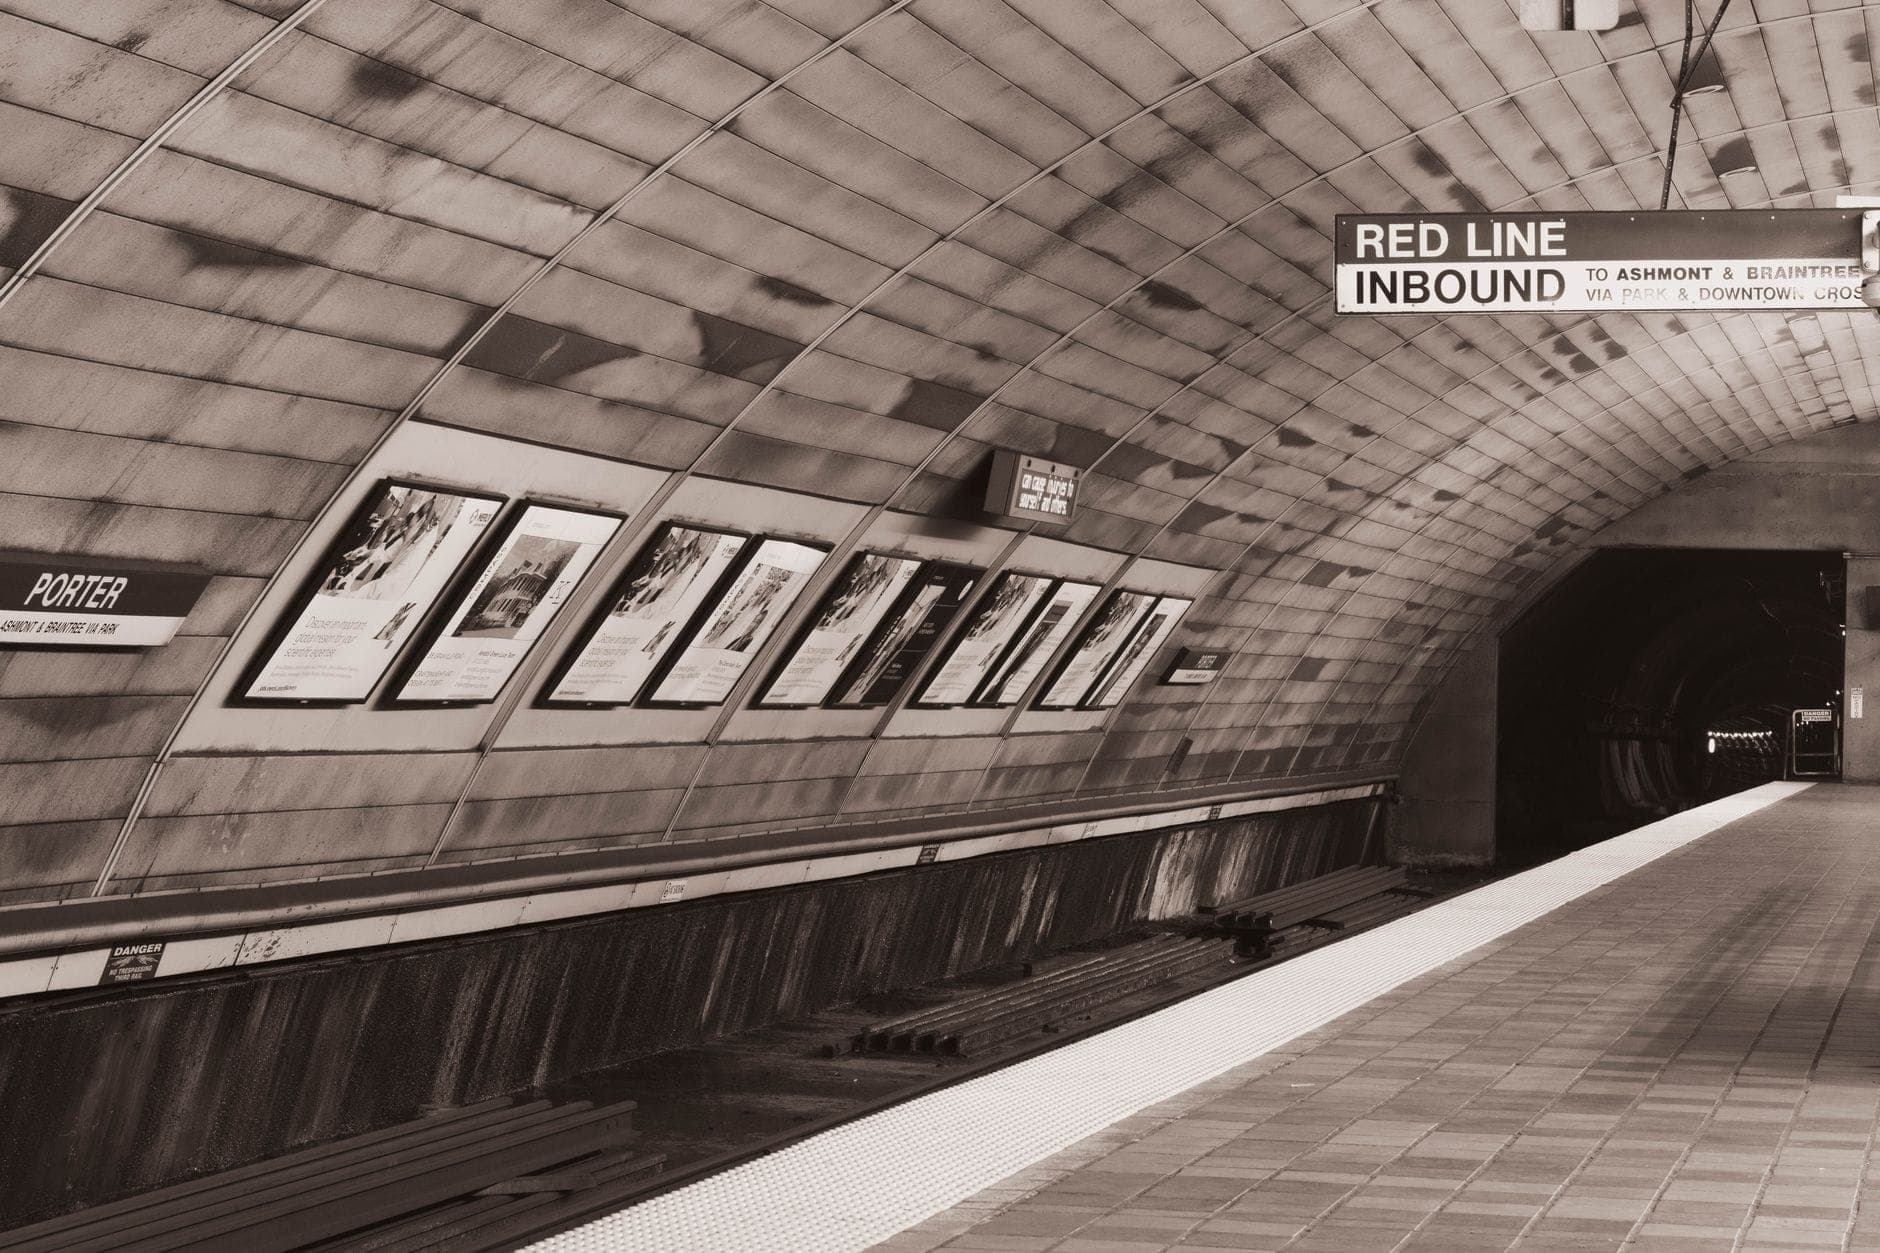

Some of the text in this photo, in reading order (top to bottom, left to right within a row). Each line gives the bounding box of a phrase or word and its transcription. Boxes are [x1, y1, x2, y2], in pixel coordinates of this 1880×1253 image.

[1356, 221, 1567, 258] RED LINE
[1585, 265, 1861, 281] TO ASHMONT & BRAINTREE
[1356, 268, 1566, 304] INBOUND
[1586, 288, 1613, 301] VIA
[1621, 287, 1669, 301] PARK
[1678, 287, 1689, 301] &
[1699, 286, 1804, 301] DOWNTOWN
[23, 572, 129, 609] PORTER
[0, 620, 38, 632] ASHMONT
[44, 622, 87, 633] BRAINTREE
[114, 944, 162, 956] DANGER
